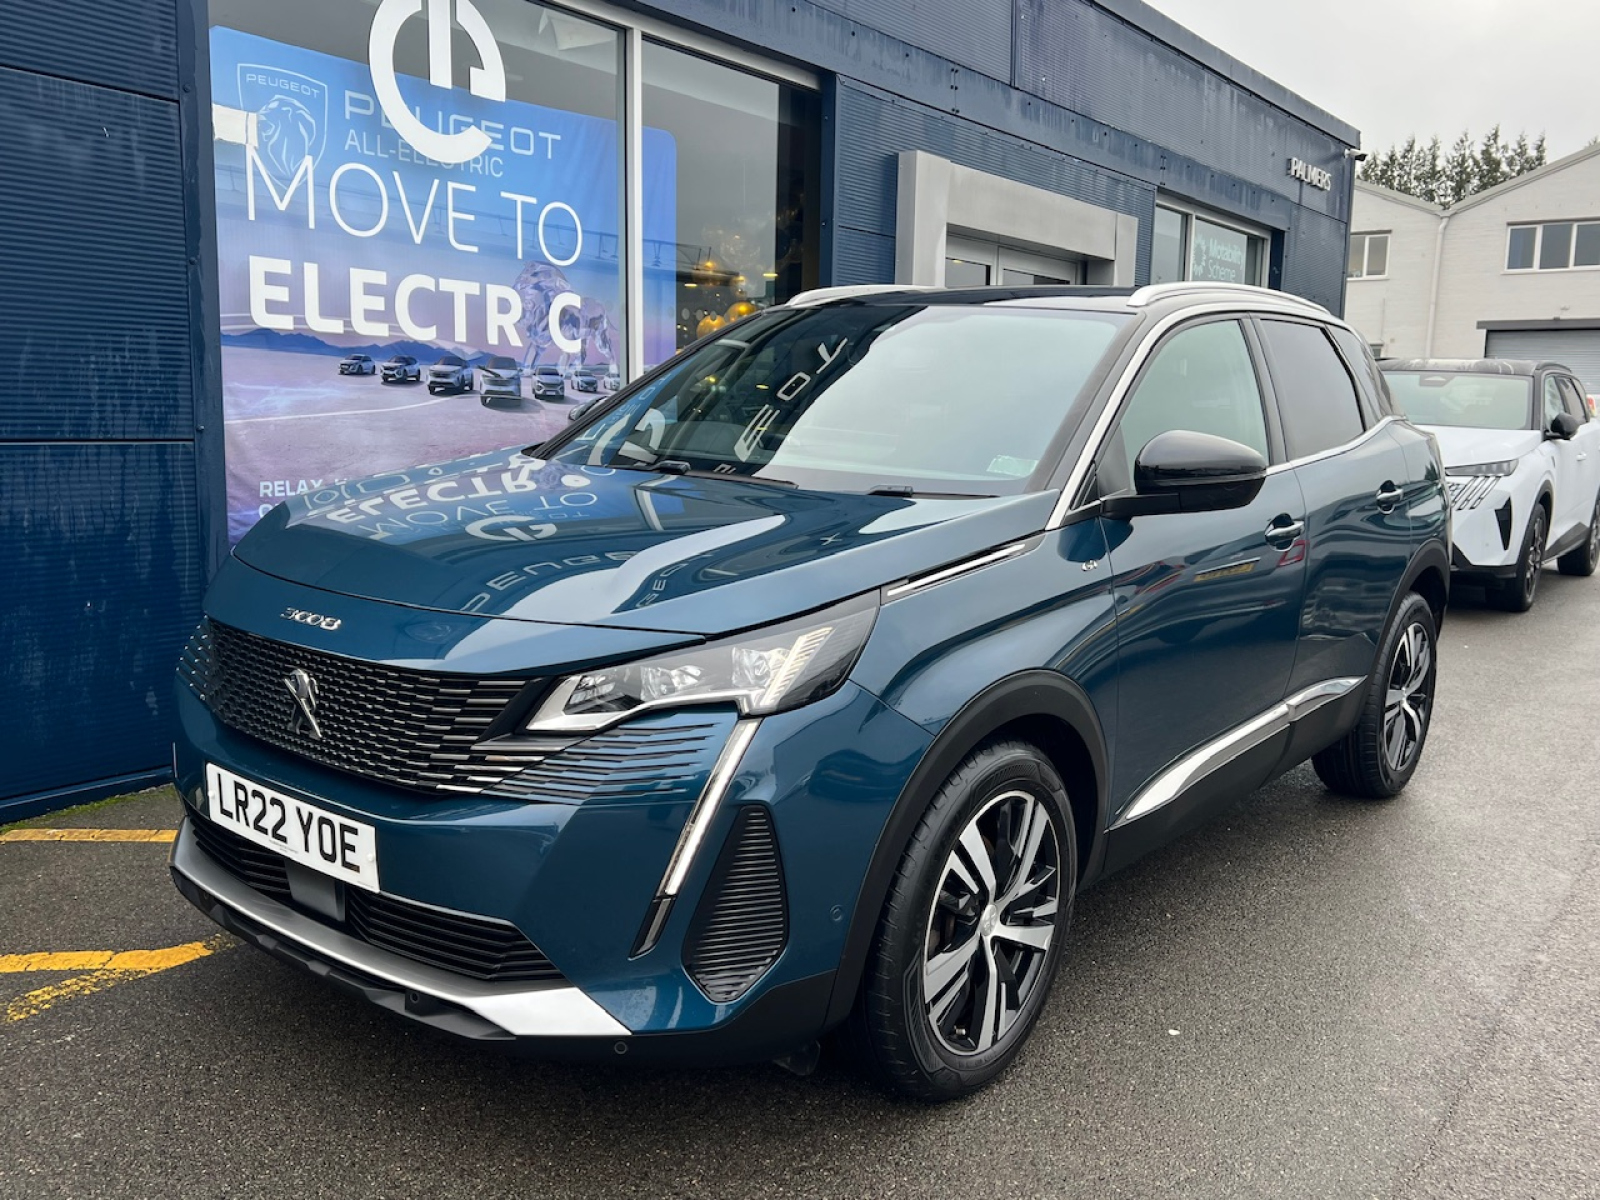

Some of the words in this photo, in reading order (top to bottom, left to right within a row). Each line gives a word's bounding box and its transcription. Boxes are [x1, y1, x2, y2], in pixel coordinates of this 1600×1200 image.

[245, 73, 320, 99] PEUGEOT
[344, 89, 562, 160] PUGEOT
[1290, 156, 1332, 191] PALMERS
[245, 146, 479, 254] MOVE
[500, 191, 583, 267] TO
[1208, 259, 1236, 283] Scheme
[248, 254, 582, 354] ELECTRC
[280, 607, 342, 630] 3008
[216, 772, 289, 845] LR22
[295, 805, 361, 874] YOE
